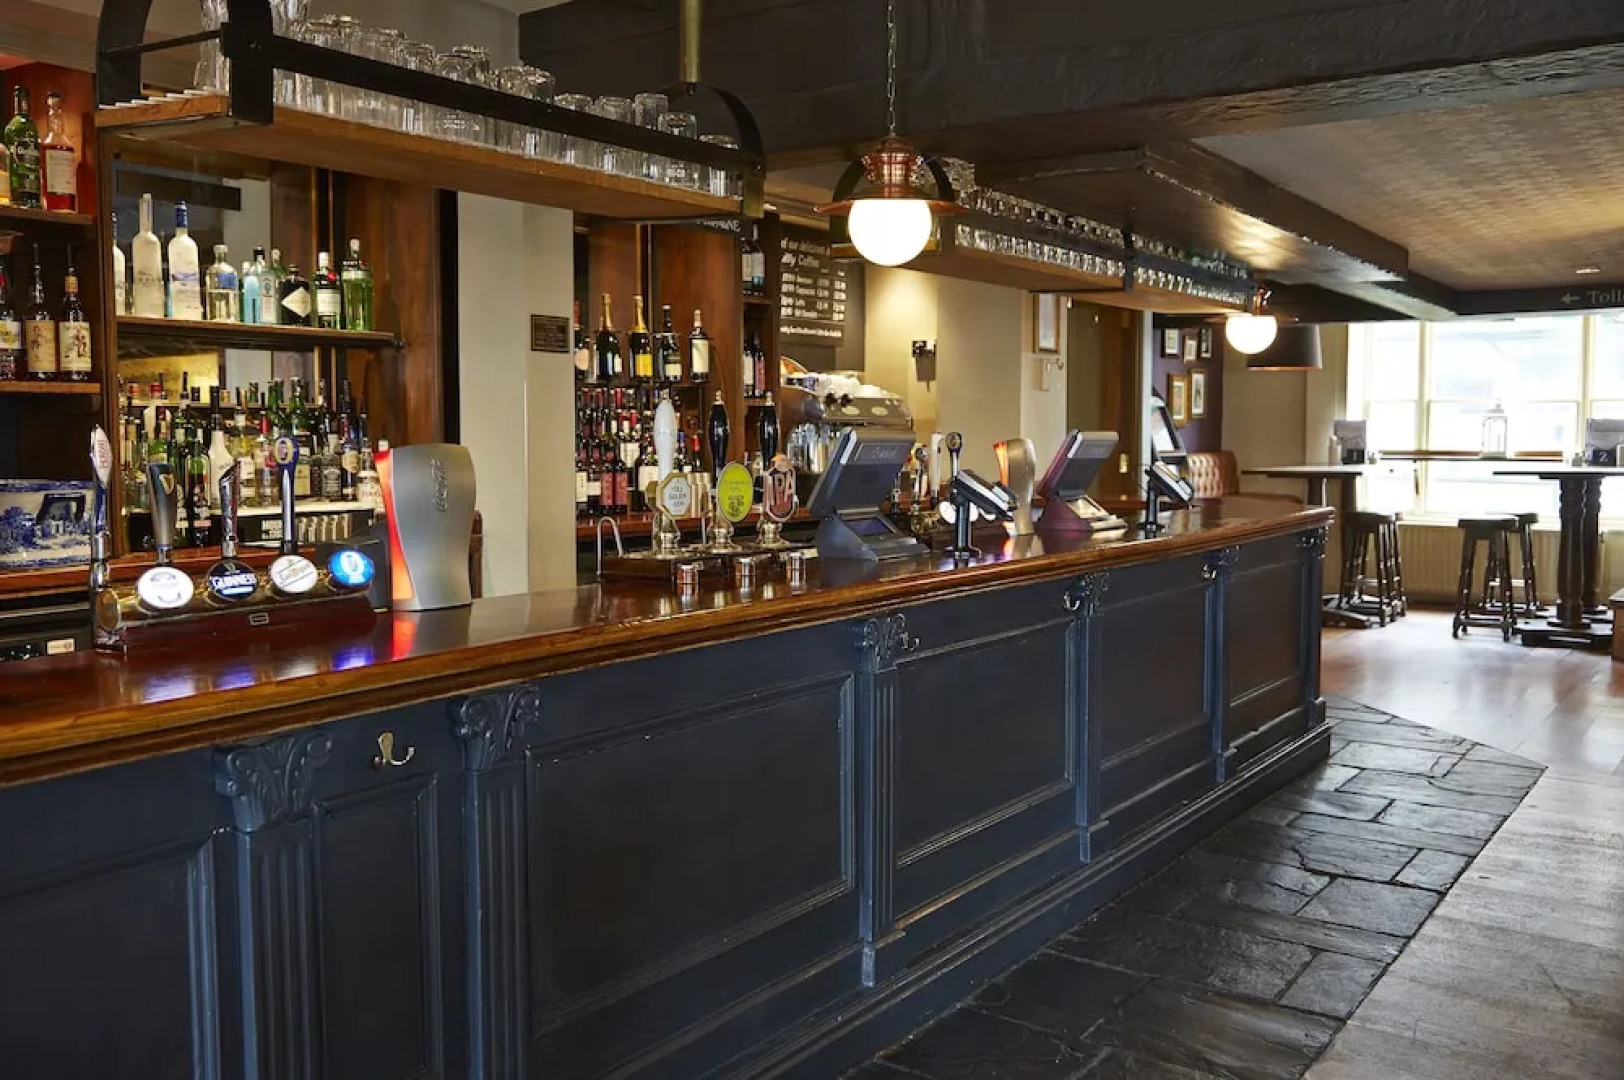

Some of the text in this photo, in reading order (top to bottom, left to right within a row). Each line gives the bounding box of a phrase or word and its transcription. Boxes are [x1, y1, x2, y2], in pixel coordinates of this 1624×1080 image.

[1586, 288, 1624, 305] Toil
[1599, 450, 1609, 462] 2
[768, 468, 797, 506] IPA
